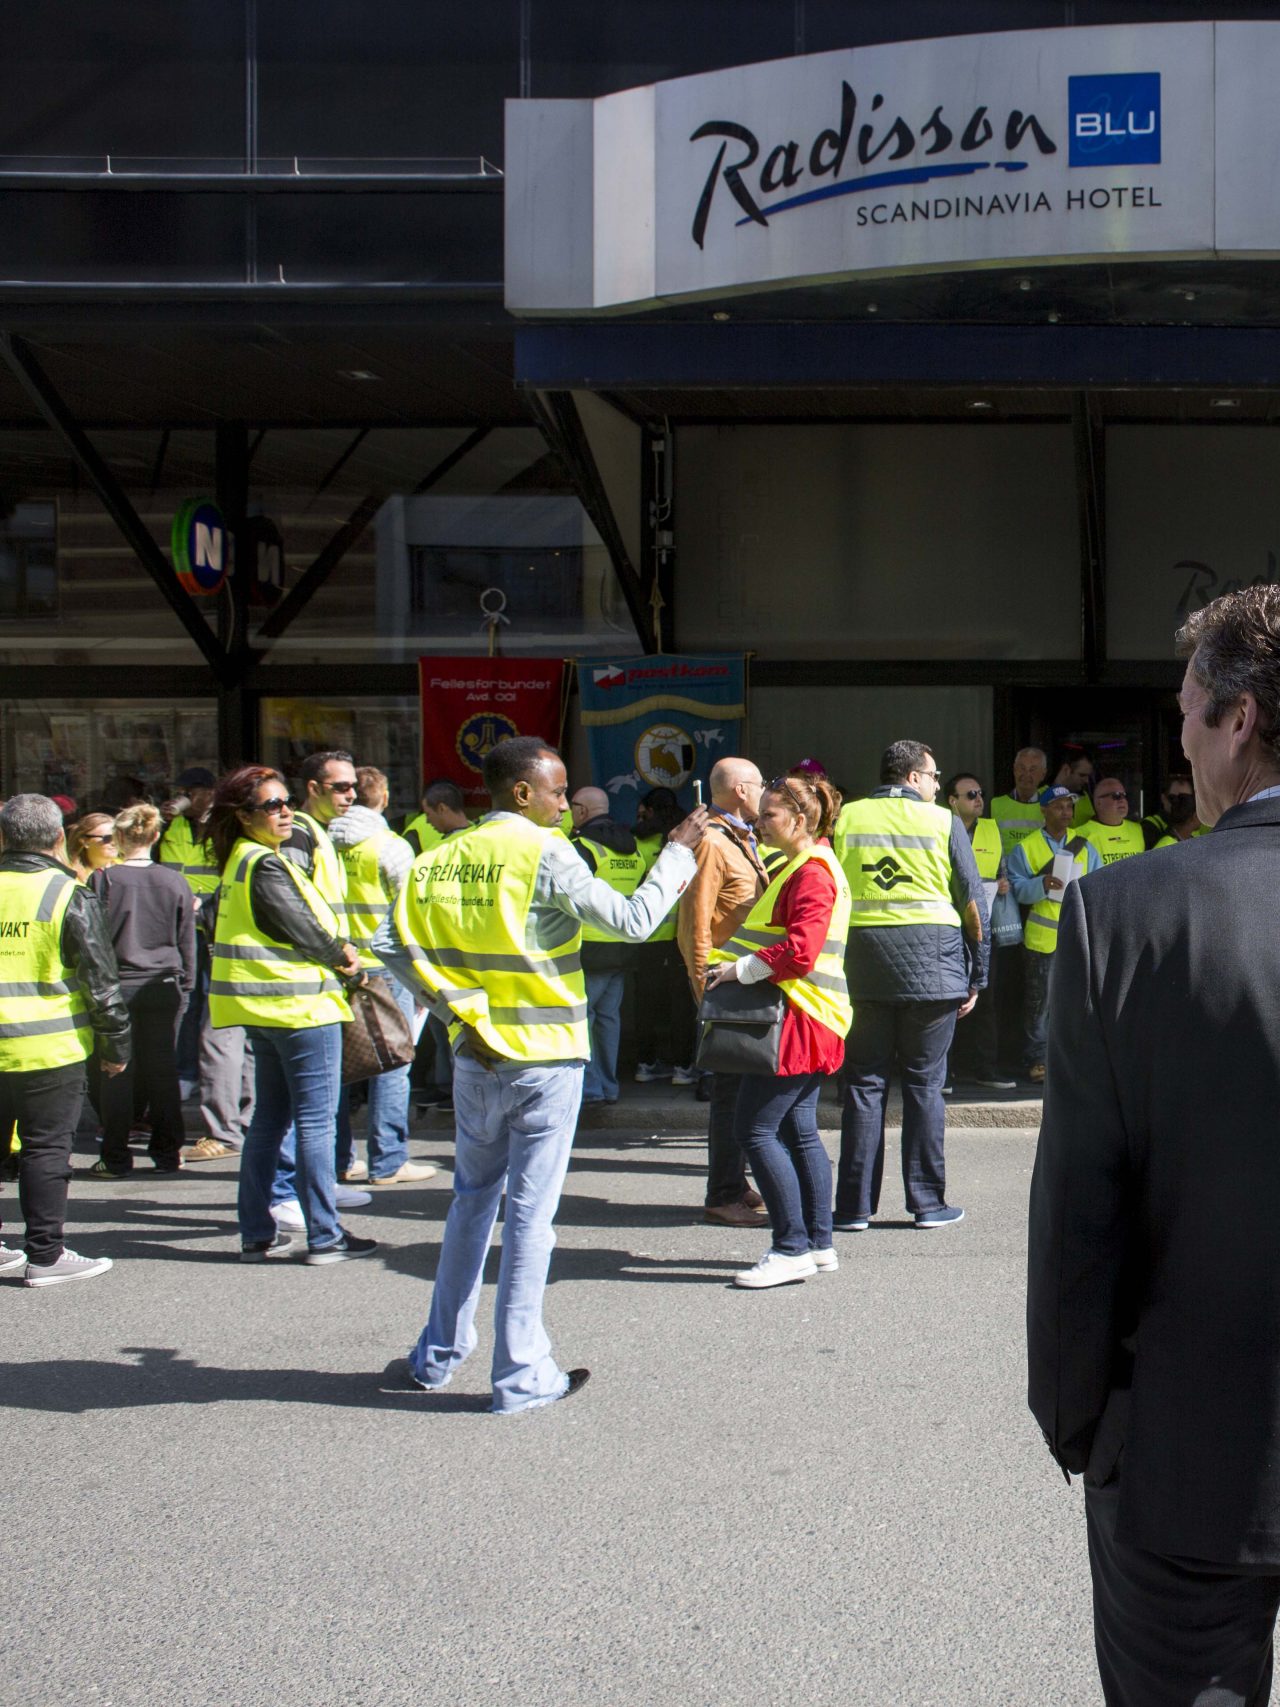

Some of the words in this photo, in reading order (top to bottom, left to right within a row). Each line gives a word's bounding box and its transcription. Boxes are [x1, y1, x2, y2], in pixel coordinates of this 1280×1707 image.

[1075, 110, 1156, 137] BLU
[690, 80, 1057, 250] Radisson
[856, 191, 1052, 227] SCANDINAVIA
[1066, 187, 1162, 210] HOTEL
[430, 677, 552, 690] Fellesforbundet
[415, 863, 505, 884] STREIKEVAKT
